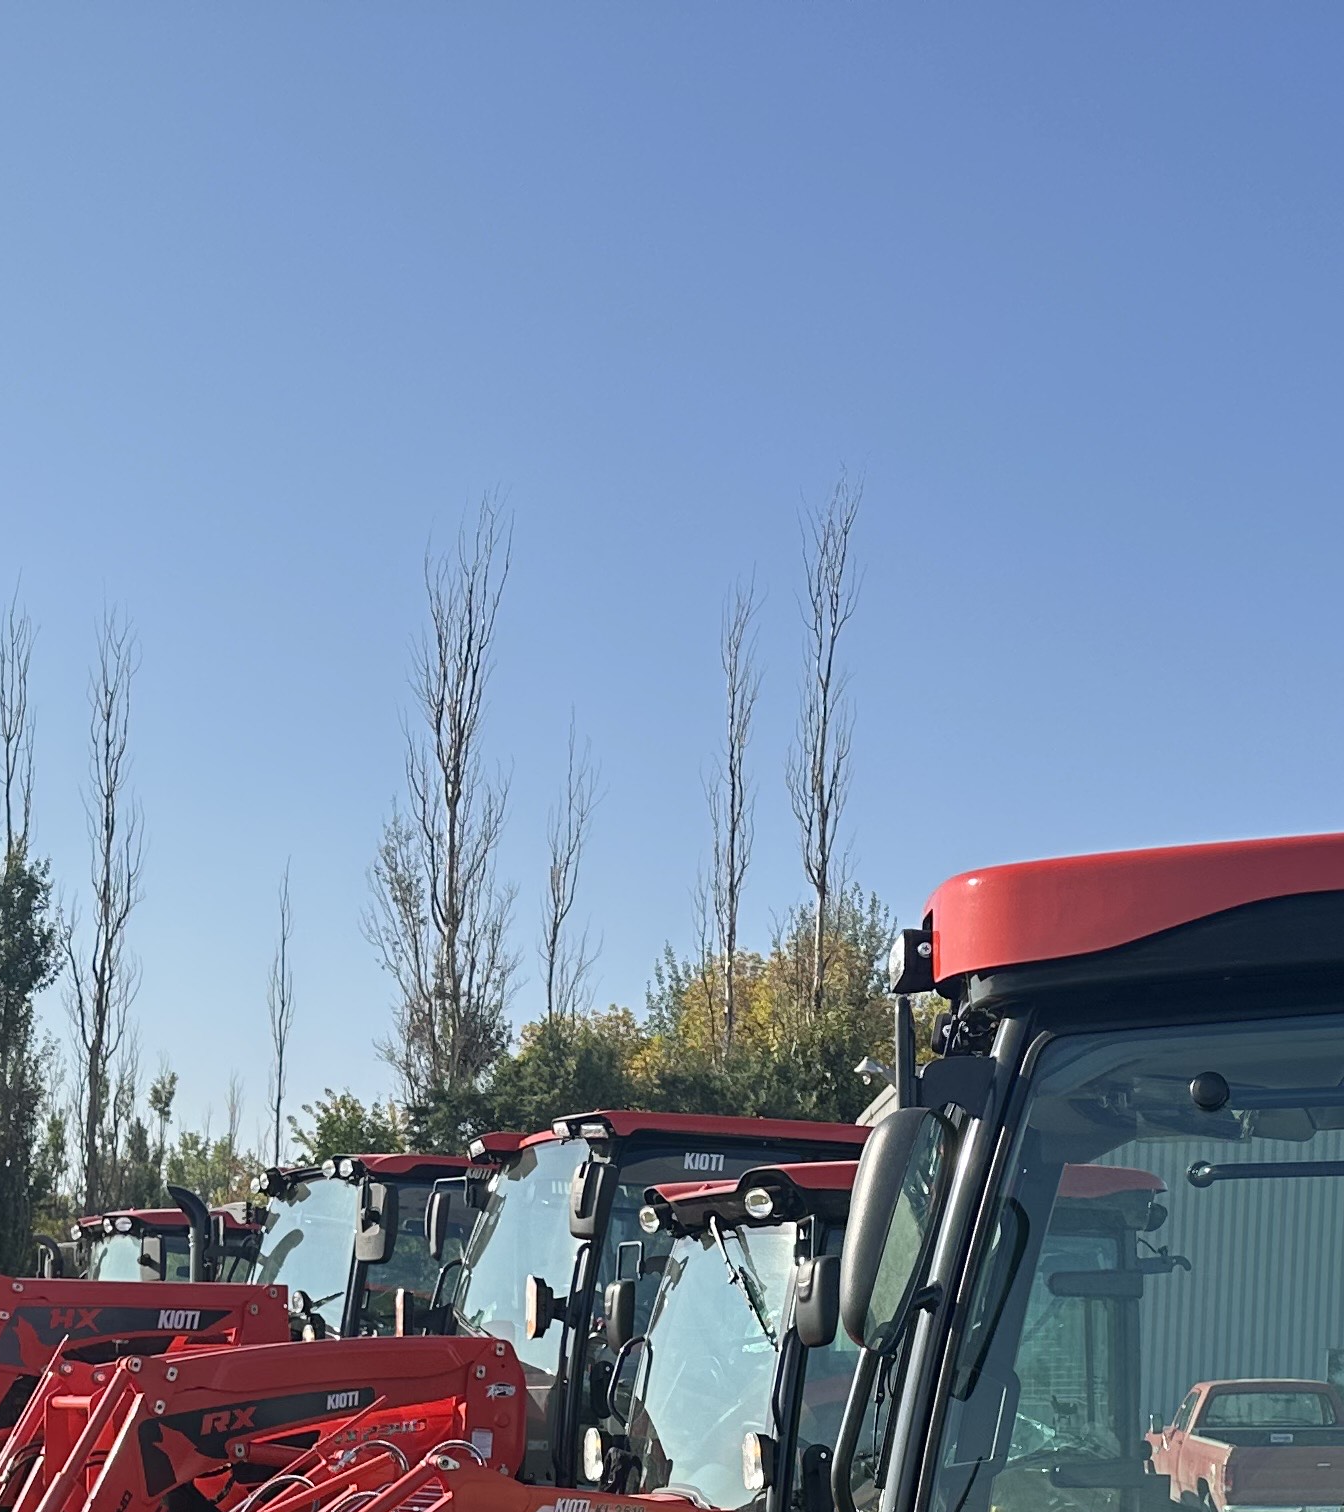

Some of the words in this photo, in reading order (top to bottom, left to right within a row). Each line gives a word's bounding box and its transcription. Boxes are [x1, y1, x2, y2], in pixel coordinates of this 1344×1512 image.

[683, 1152, 725, 1172] KIOTI
[50, 1308, 103, 1332] HX
[158, 1309, 201, 1330] KIOTI
[326, 1391, 359, 1410] KIOTI
[200, 1407, 256, 1435] RX
